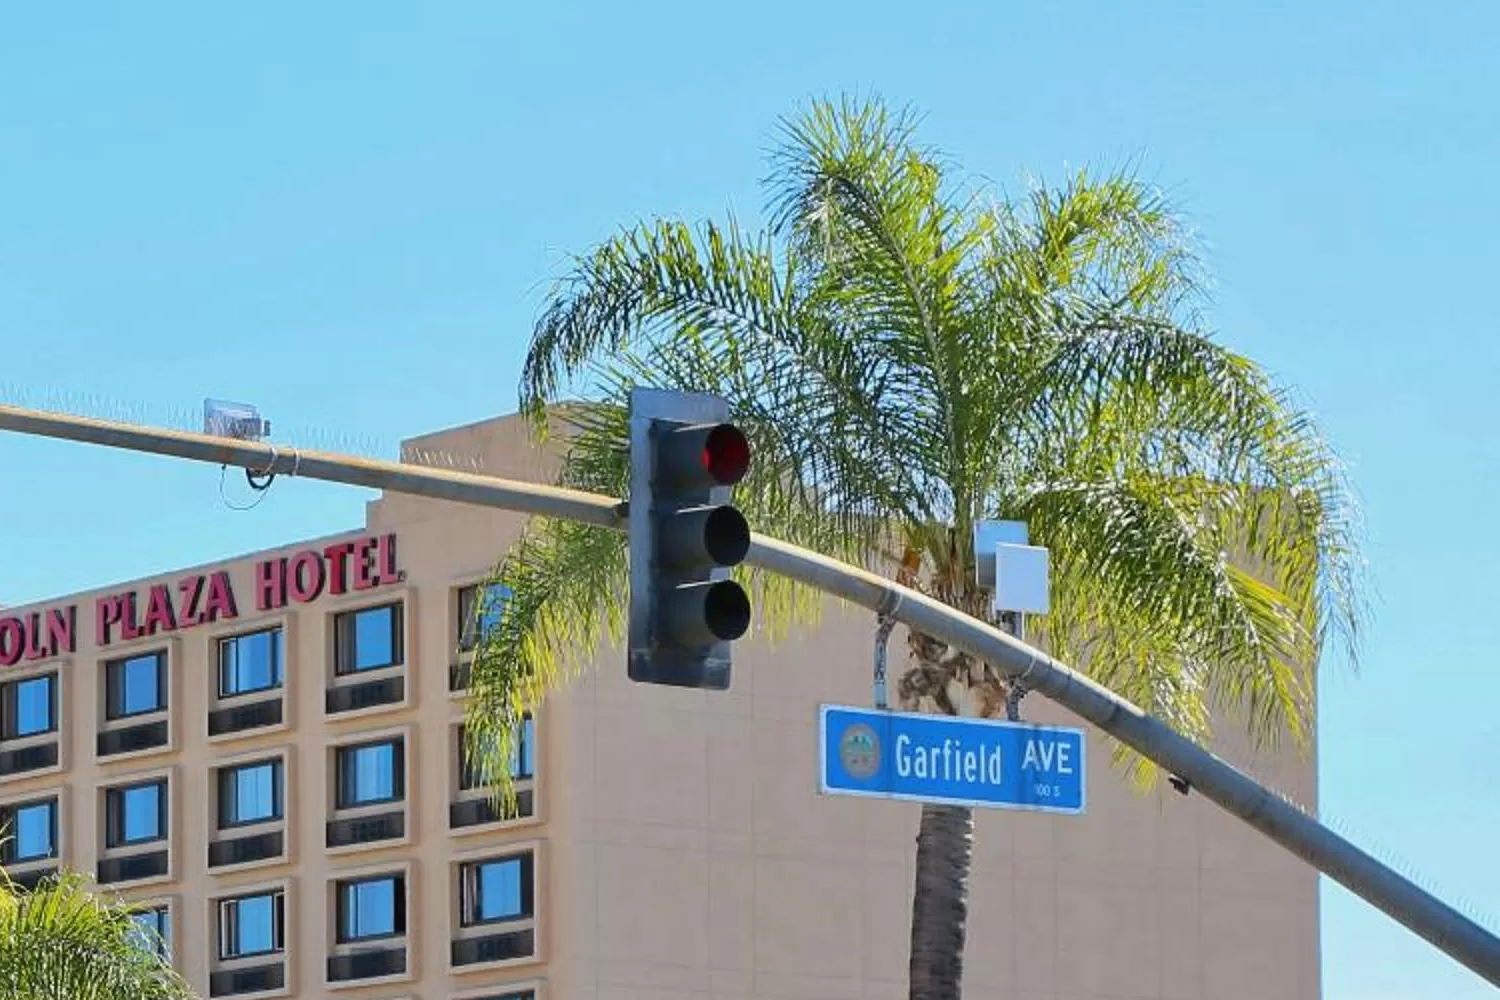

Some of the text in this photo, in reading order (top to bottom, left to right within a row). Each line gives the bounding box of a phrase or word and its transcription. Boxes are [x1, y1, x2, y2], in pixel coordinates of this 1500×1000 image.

[95, 570, 238, 646] PLAZA
[255, 532, 401, 611] HOTEL
[895, 733, 1073, 785] Garfield AVE
[1034, 783, 1051, 797] 100
